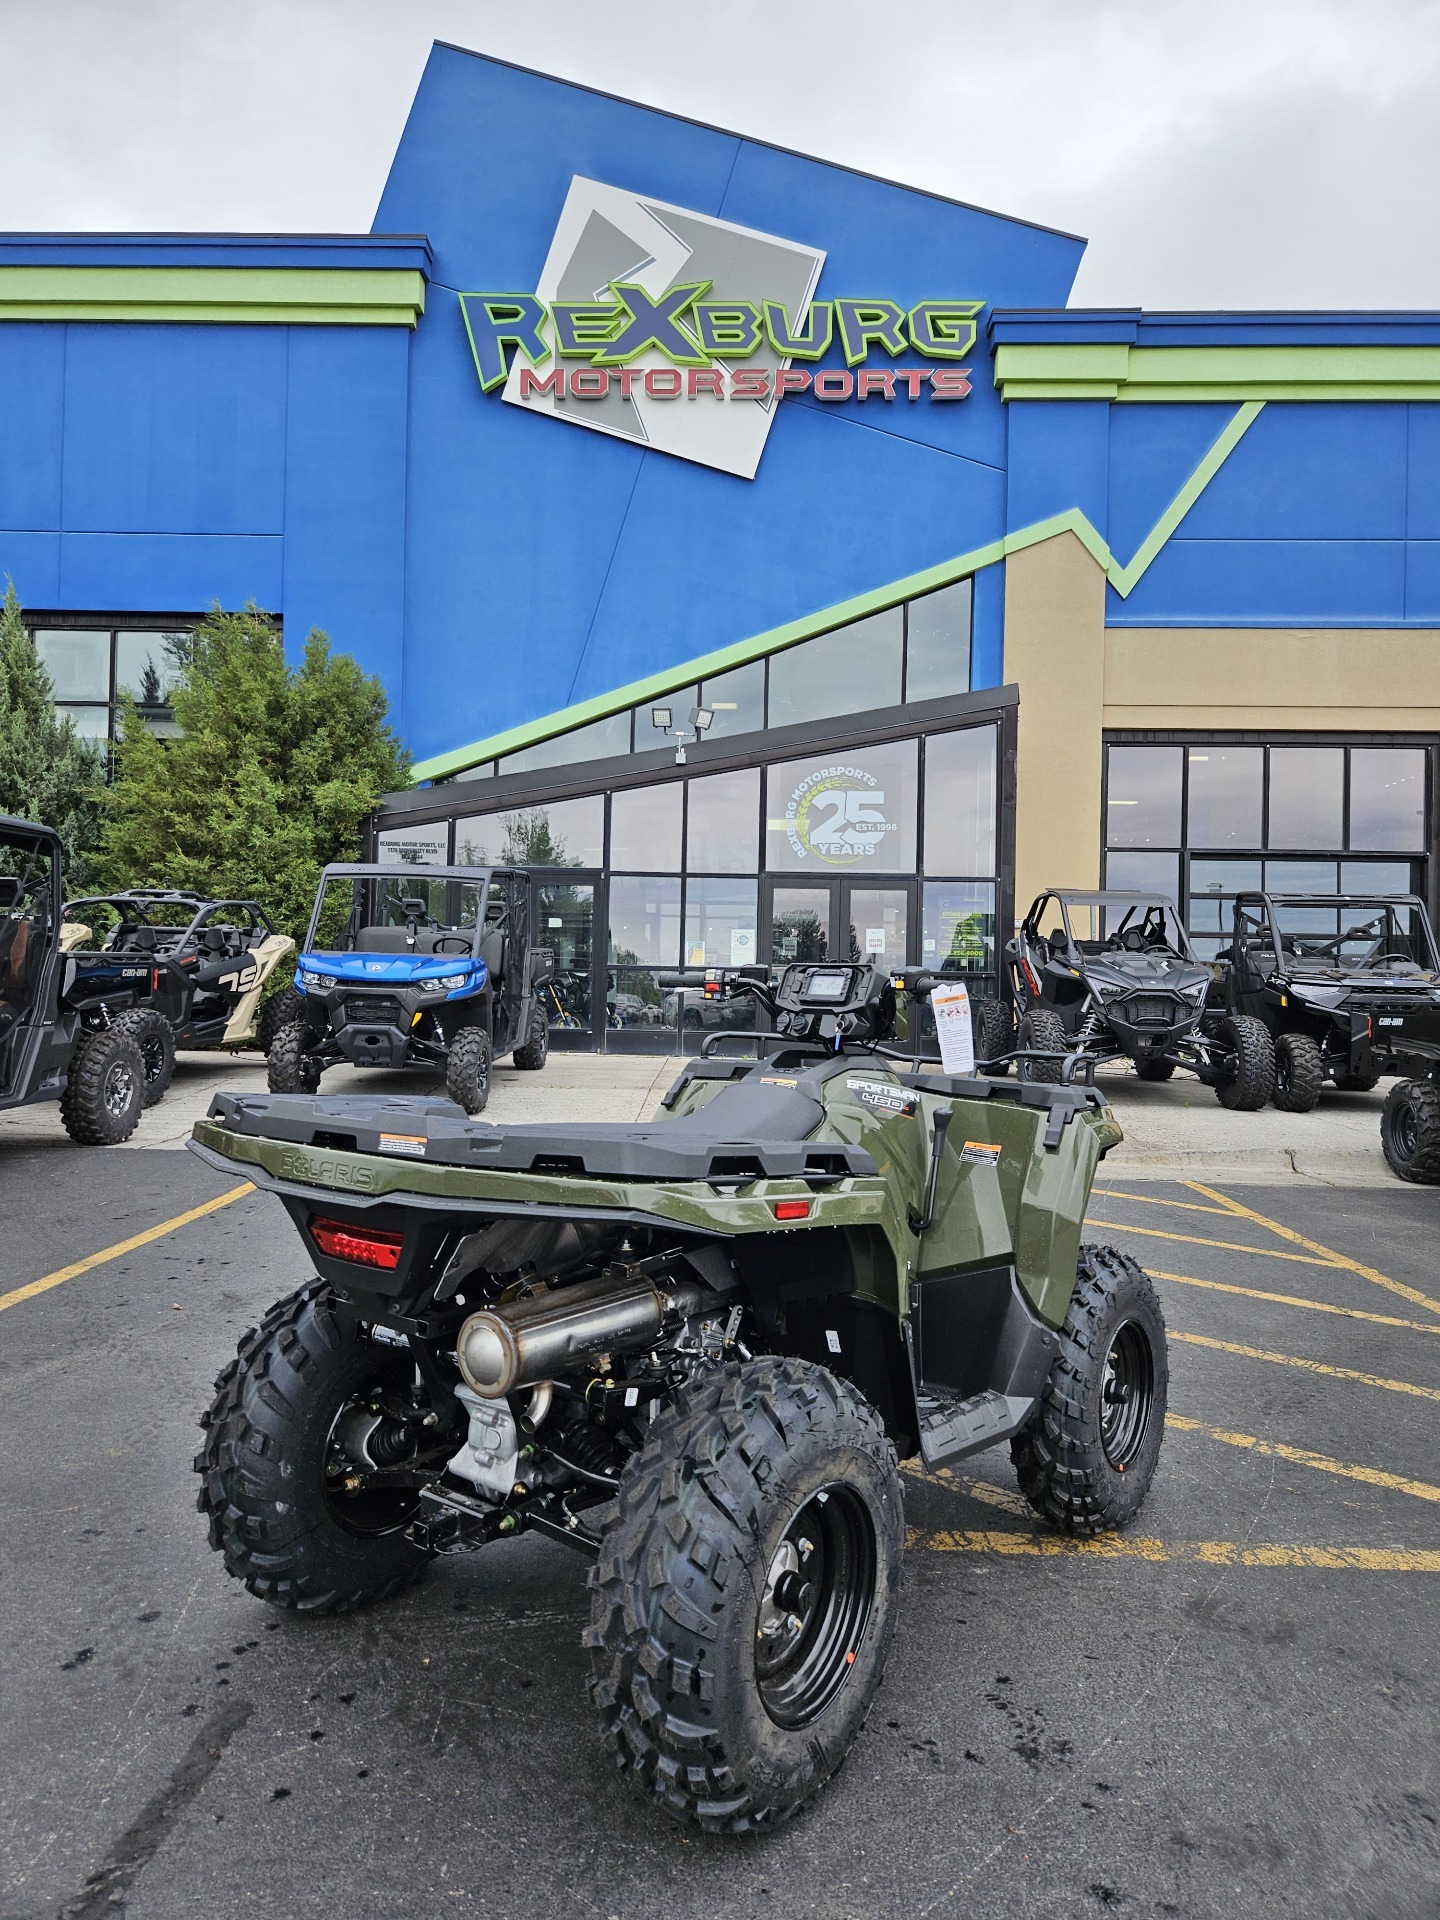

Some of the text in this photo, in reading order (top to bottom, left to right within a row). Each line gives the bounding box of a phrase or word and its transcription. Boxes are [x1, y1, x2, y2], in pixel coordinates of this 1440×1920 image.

[459, 280, 987, 394] REXBURG
[519, 368, 972, 401] MOTORSPORTS
[791, 766, 877, 801] MOTORSPORTS
[810, 790, 886, 846] 25
[817, 843, 876, 856] YEARS
[846, 1078, 921, 1103] SPORTSMAN
[861, 1092, 904, 1111] 450
[279, 1152, 373, 1189] POLARIS
